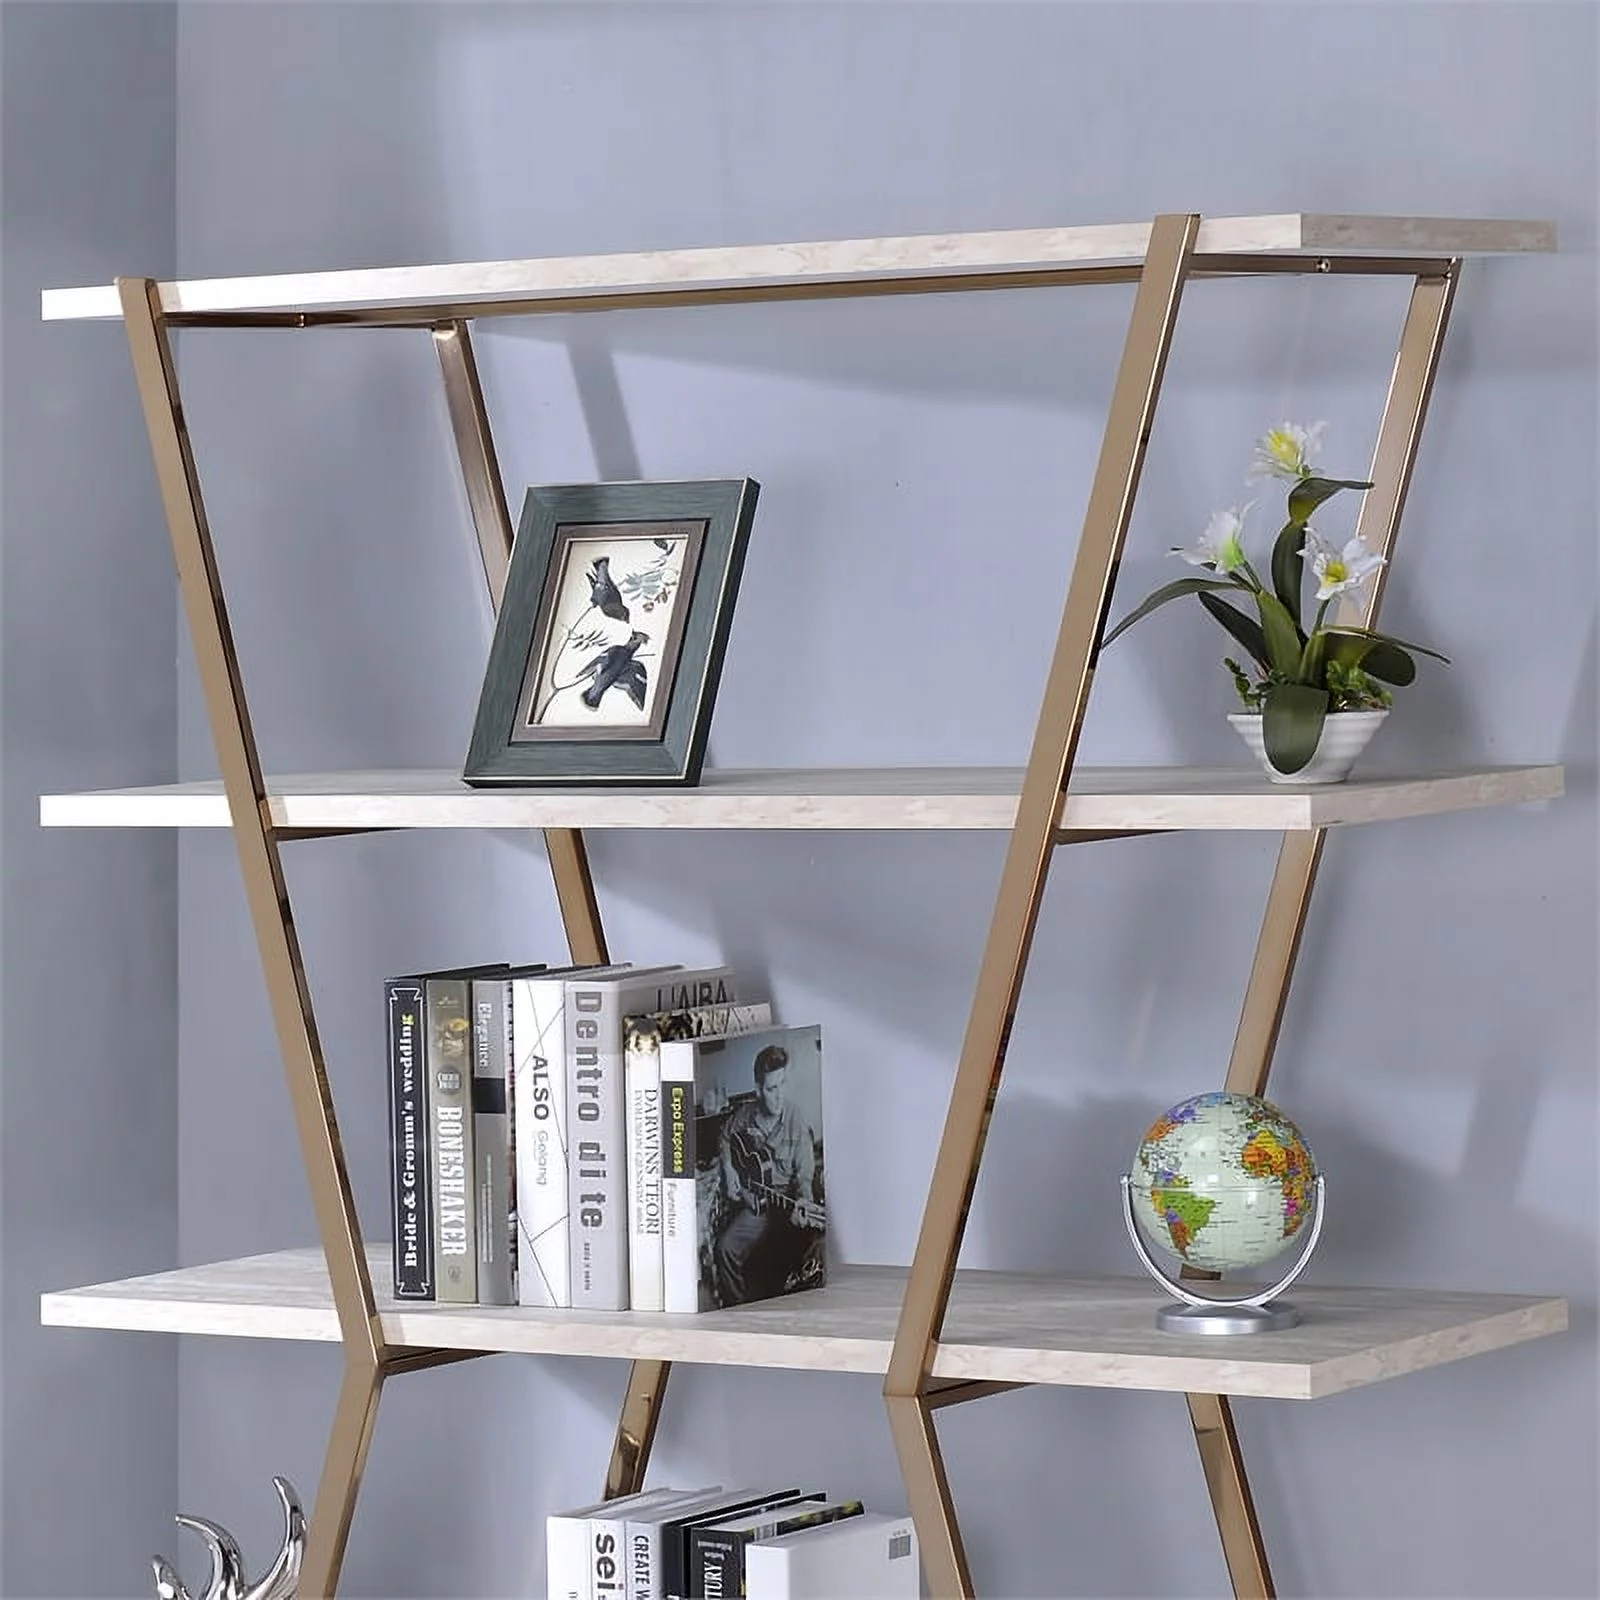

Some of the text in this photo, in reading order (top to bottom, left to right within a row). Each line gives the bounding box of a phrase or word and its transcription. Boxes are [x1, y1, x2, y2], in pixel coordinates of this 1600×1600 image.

[400, 1014, 415, 1093] wedding
[533, 1055, 549, 1120] ALSO
[575, 991, 607, 1227] Dentro di te
[645, 1089, 660, 1235] DARWINS TEORI
[671, 1087, 685, 1173] Expo Express
[403, 1190, 416, 1209] &
[437, 1105, 467, 1255] BONESHAKER
[667, 1182, 678, 1238] Furniture
[403, 1212, 417, 1267] Bride
[596, 1533, 625, 1590] sei
[633, 1535, 650, 1585] CREATE
